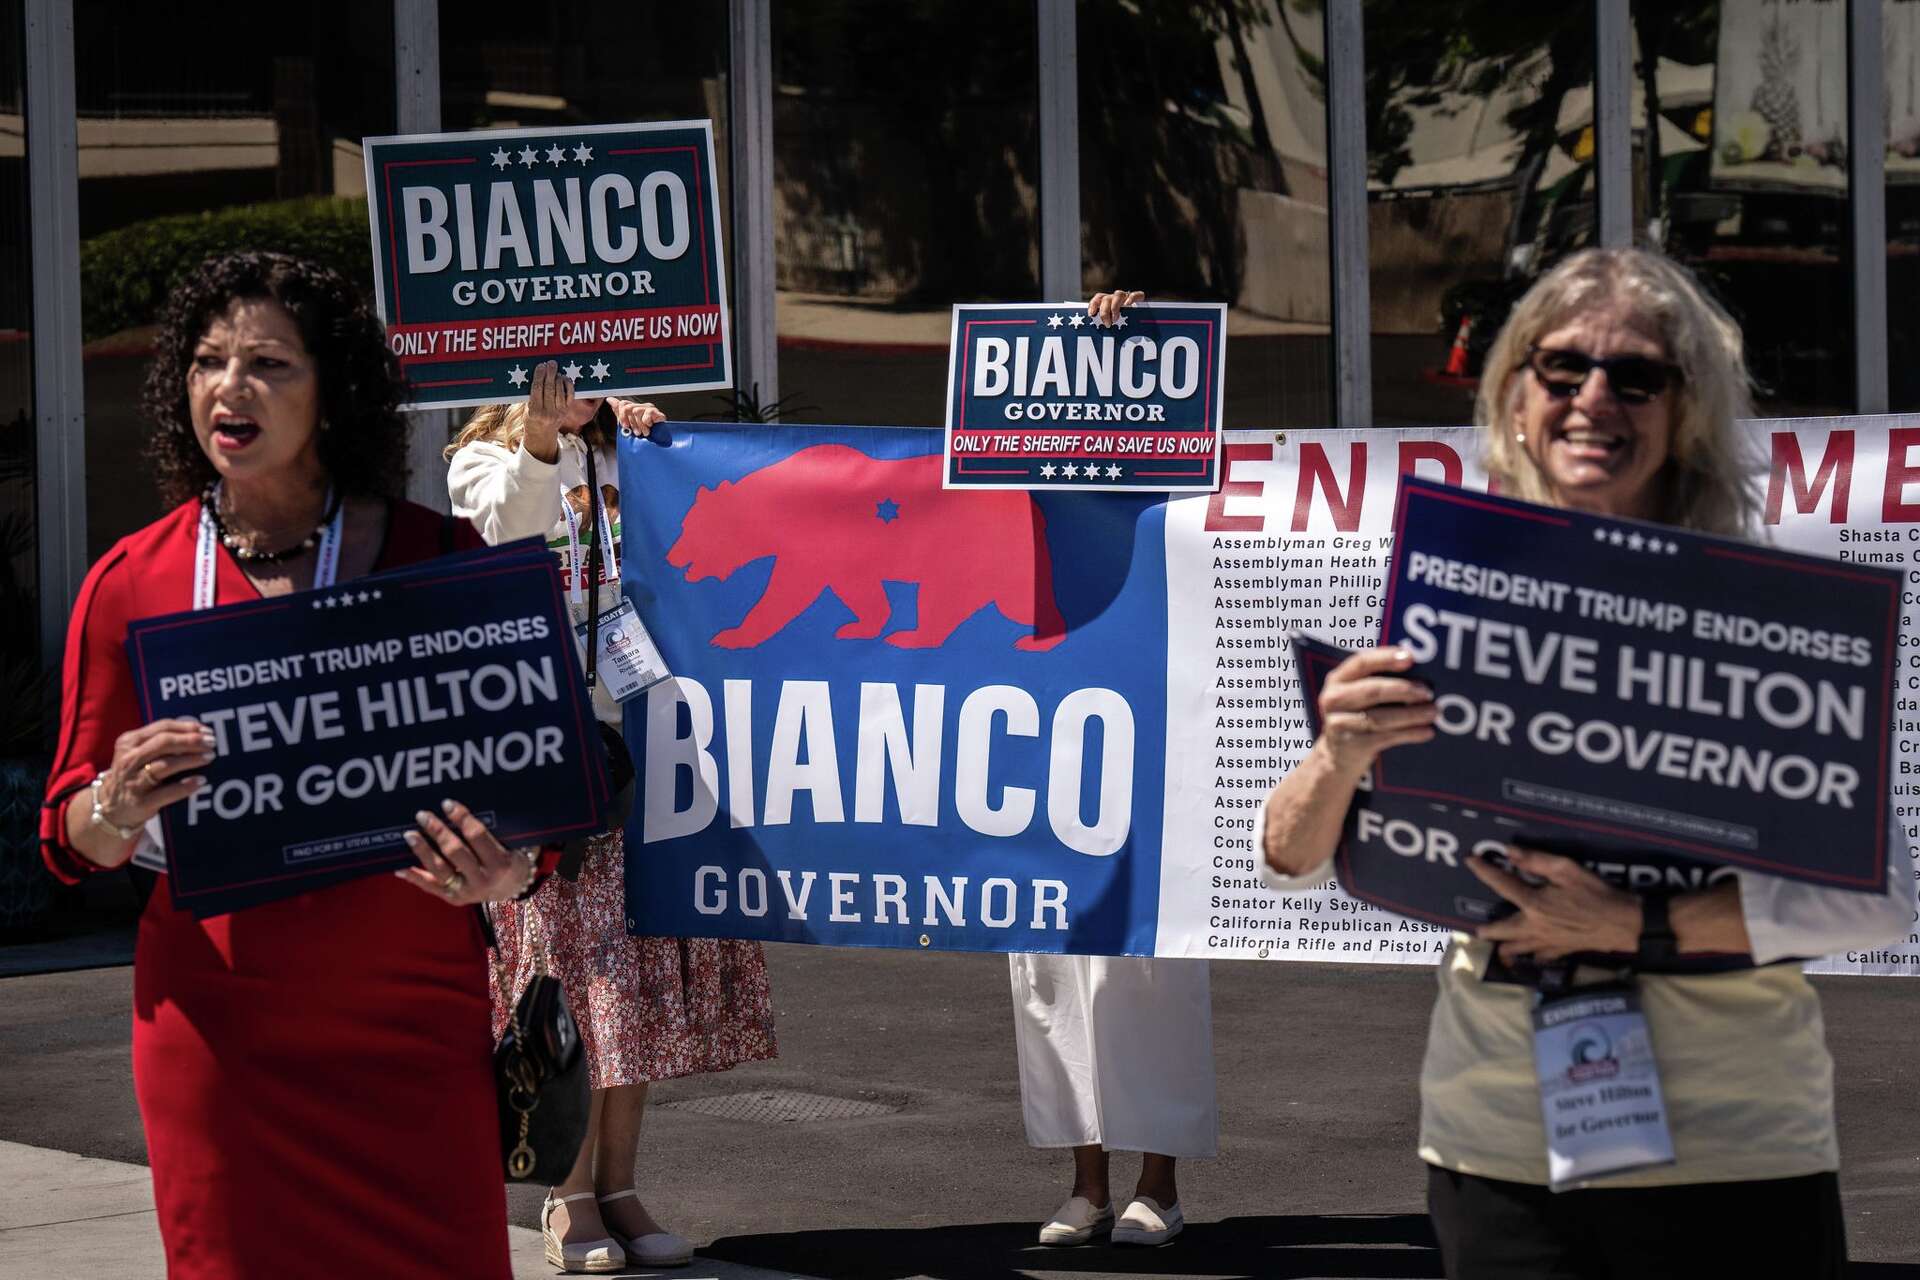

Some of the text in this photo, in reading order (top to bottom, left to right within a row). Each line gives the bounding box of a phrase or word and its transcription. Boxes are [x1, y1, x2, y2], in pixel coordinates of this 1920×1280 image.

[402, 170, 690, 274] BIANCO
[452, 270, 655, 306] GOVERNOR
[391, 312, 718, 356] ONLY THE SHERIFF CAN SAVE US NOW
[974, 336, 1199, 399] BIANCO
[1004, 403, 1165, 422] GOVERNOR
[953, 435, 1214, 454] ONLY THE SHERIFF CAN SAVE US NOW
[1839, 529, 1900, 542] Shasta
[1213, 537, 1325, 551] Assemblyman
[1332, 538, 1372, 551] Greg
[1213, 556, 1323, 570] Assemblyman
[1330, 556, 1377, 568] Heath
[1840, 551, 1904, 562] Plumas
[1214, 576, 1382, 590] Assemblyman Phillip
[1214, 596, 1322, 610] Assemblyman
[1329, 596, 1360, 608] Jeff
[1407, 551, 1872, 667] PRESIDENT TRUMP ENDORSES
[1216, 616, 1322, 630] Assemblyman
[1329, 616, 1357, 628] Joe
[1216, 636, 1291, 650] Assembly
[160, 615, 549, 700] PRESIDENT TRUMP ENDORSES
[611, 647, 640, 666] Tamara
[1216, 656, 1297, 670] Assembly
[1401, 604, 1865, 740] STEVE HILTON
[1216, 676, 1301, 690] Assemblym
[178, 656, 558, 760] TEVE HILTON
[1216, 696, 1305, 711] Assemblym
[1216, 716, 1312, 731] Assemblywo
[1216, 736, 1312, 751] Assemblywo
[1434, 694, 1860, 810] OR GOVERNOR
[643, 675, 1135, 856] BIANCO
[1215, 756, 1303, 771] Assemblyw
[188, 726, 564, 826] FOR GOVERNOR
[1215, 776, 1281, 789] Assemb
[1214, 797, 1264, 808] Assem
[1214, 816, 1254, 831] Cong
[1214, 836, 1253, 851] Cong
[1356, 809, 1459, 868] FOR
[1213, 856, 1254, 871] Cong
[1212, 876, 1266, 889] Senato
[695, 865, 1069, 930] GOVERNOR
[1211, 896, 1275, 910] Senator
[1282, 897, 1322, 913] Kelly
[1210, 916, 1291, 930] California
[1300, 918, 1392, 934] Republican
[1208, 936, 1290, 950] California
[1298, 938, 1336, 951] Rifle
[1343, 939, 1372, 951] and
[1380, 940, 1427, 952] Pistol
[1846, 951, 1920, 965] Californ
[1581, 1109, 1660, 1134] Governor
